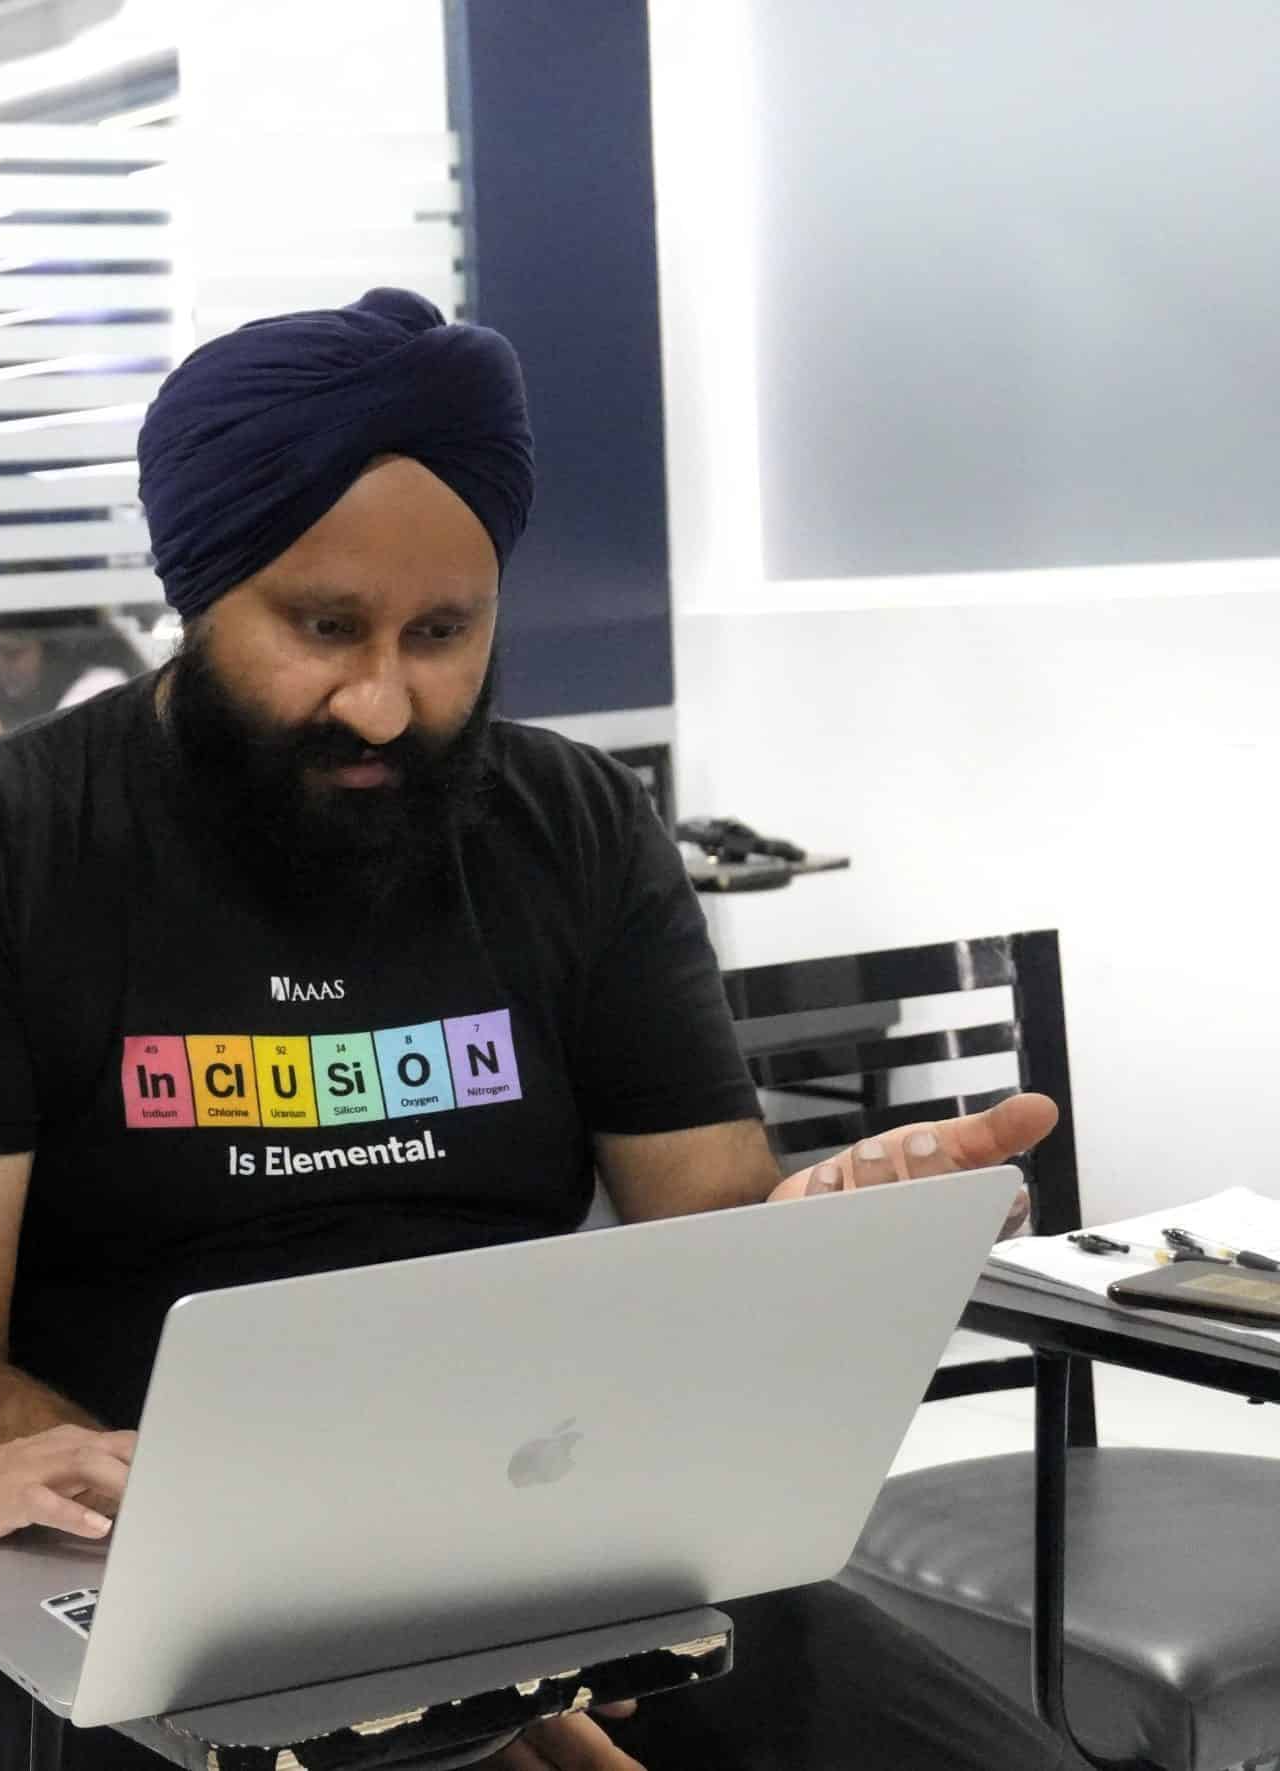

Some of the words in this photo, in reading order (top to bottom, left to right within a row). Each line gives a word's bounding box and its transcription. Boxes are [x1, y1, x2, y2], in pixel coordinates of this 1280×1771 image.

[291, 979, 345, 1002] AAAS
[215, 1044, 227, 1055] 17
[275, 1045, 287, 1056] 92
[335, 1043, 346, 1054] 14
[404, 1034, 413, 1045] 8
[472, 1023, 480, 1033] 7
[136, 1064, 176, 1098] In
[271, 1064, 297, 1099] U
[327, 1061, 366, 1097] Si
[397, 1052, 431, 1088] O
[466, 1040, 500, 1077] N
[142, 1108, 178, 1118] Indium
[207, 1106, 249, 1117] Chlorine
[270, 1108, 306, 1118] Uranium
[333, 1104, 368, 1116] Silicon
[400, 1095, 439, 1108] Oxygen
[466, 1083, 510, 1097] Nitrogen
[229, 1145, 256, 1176] Is
[265, 1130, 446, 1176] Elemental.
